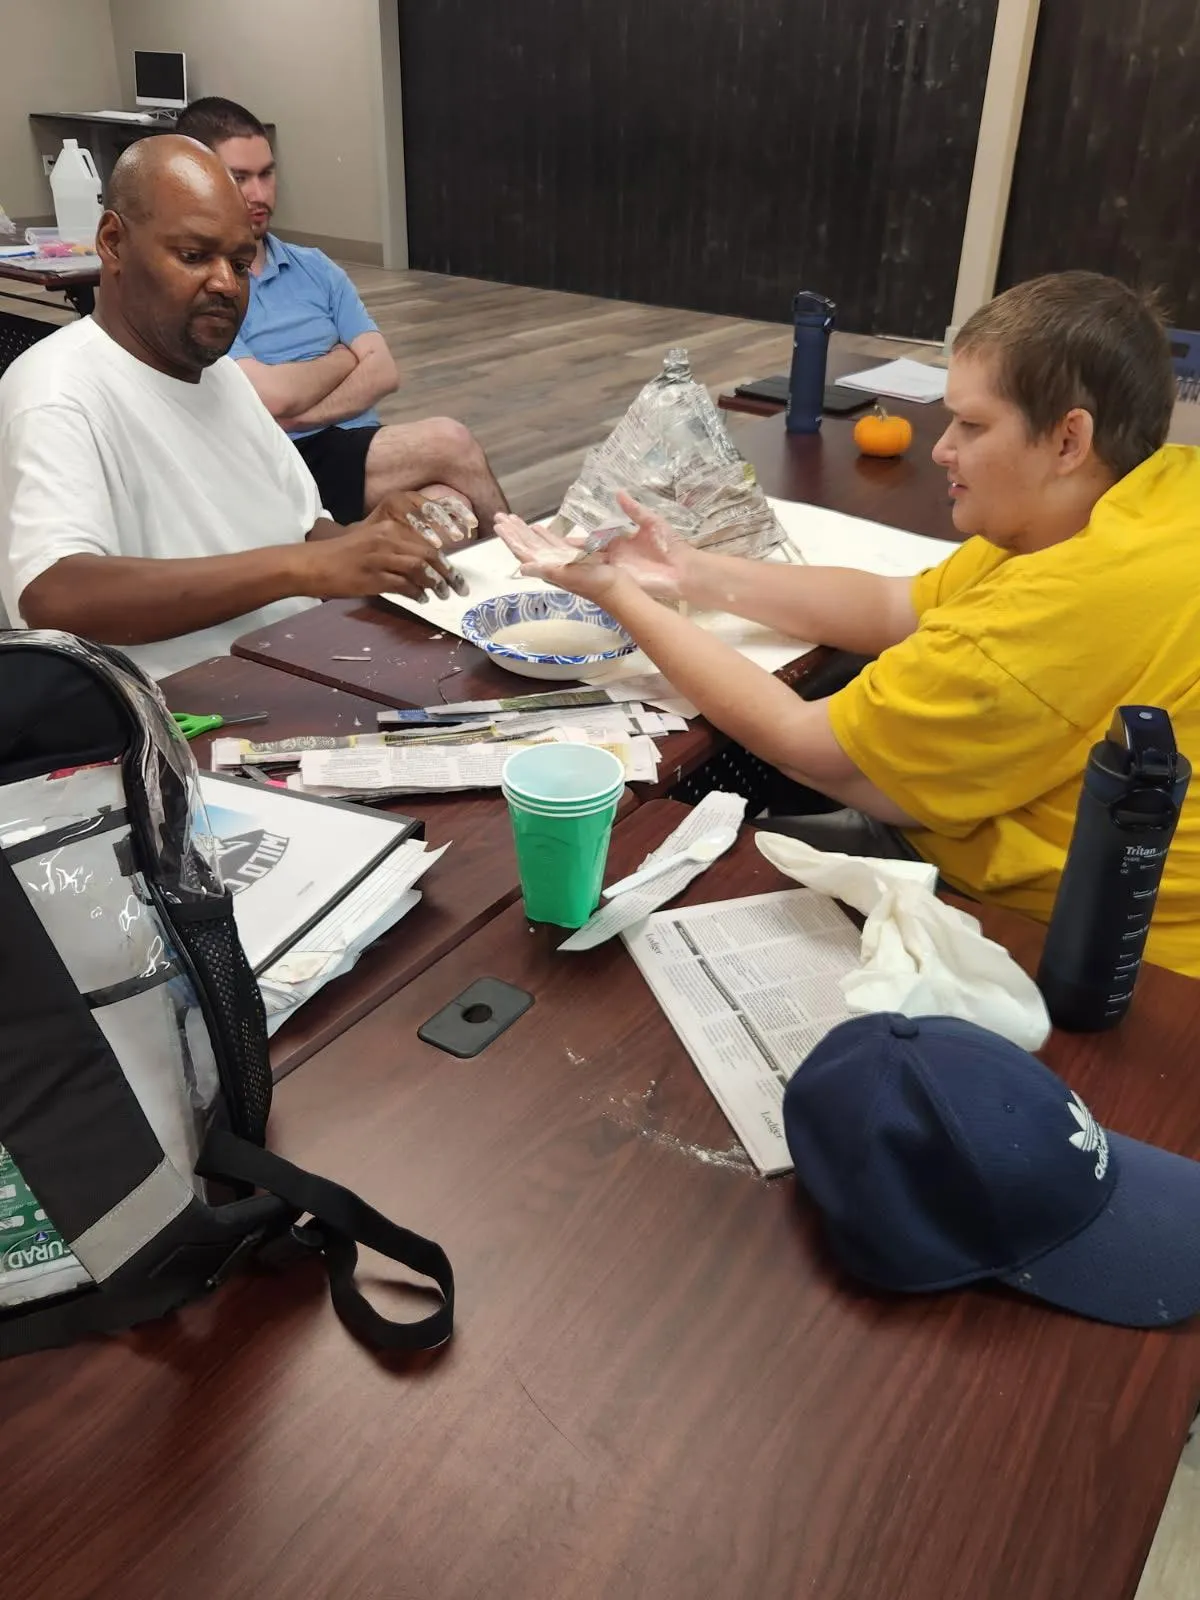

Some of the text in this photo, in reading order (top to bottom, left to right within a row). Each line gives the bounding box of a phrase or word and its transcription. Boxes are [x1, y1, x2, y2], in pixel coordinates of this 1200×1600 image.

[237, 831, 288, 879] WILD
[1125, 845, 1157, 856] Tritan
[761, 1110, 784, 1139] Ledger
[8, 1239, 70, 1269] URAD
